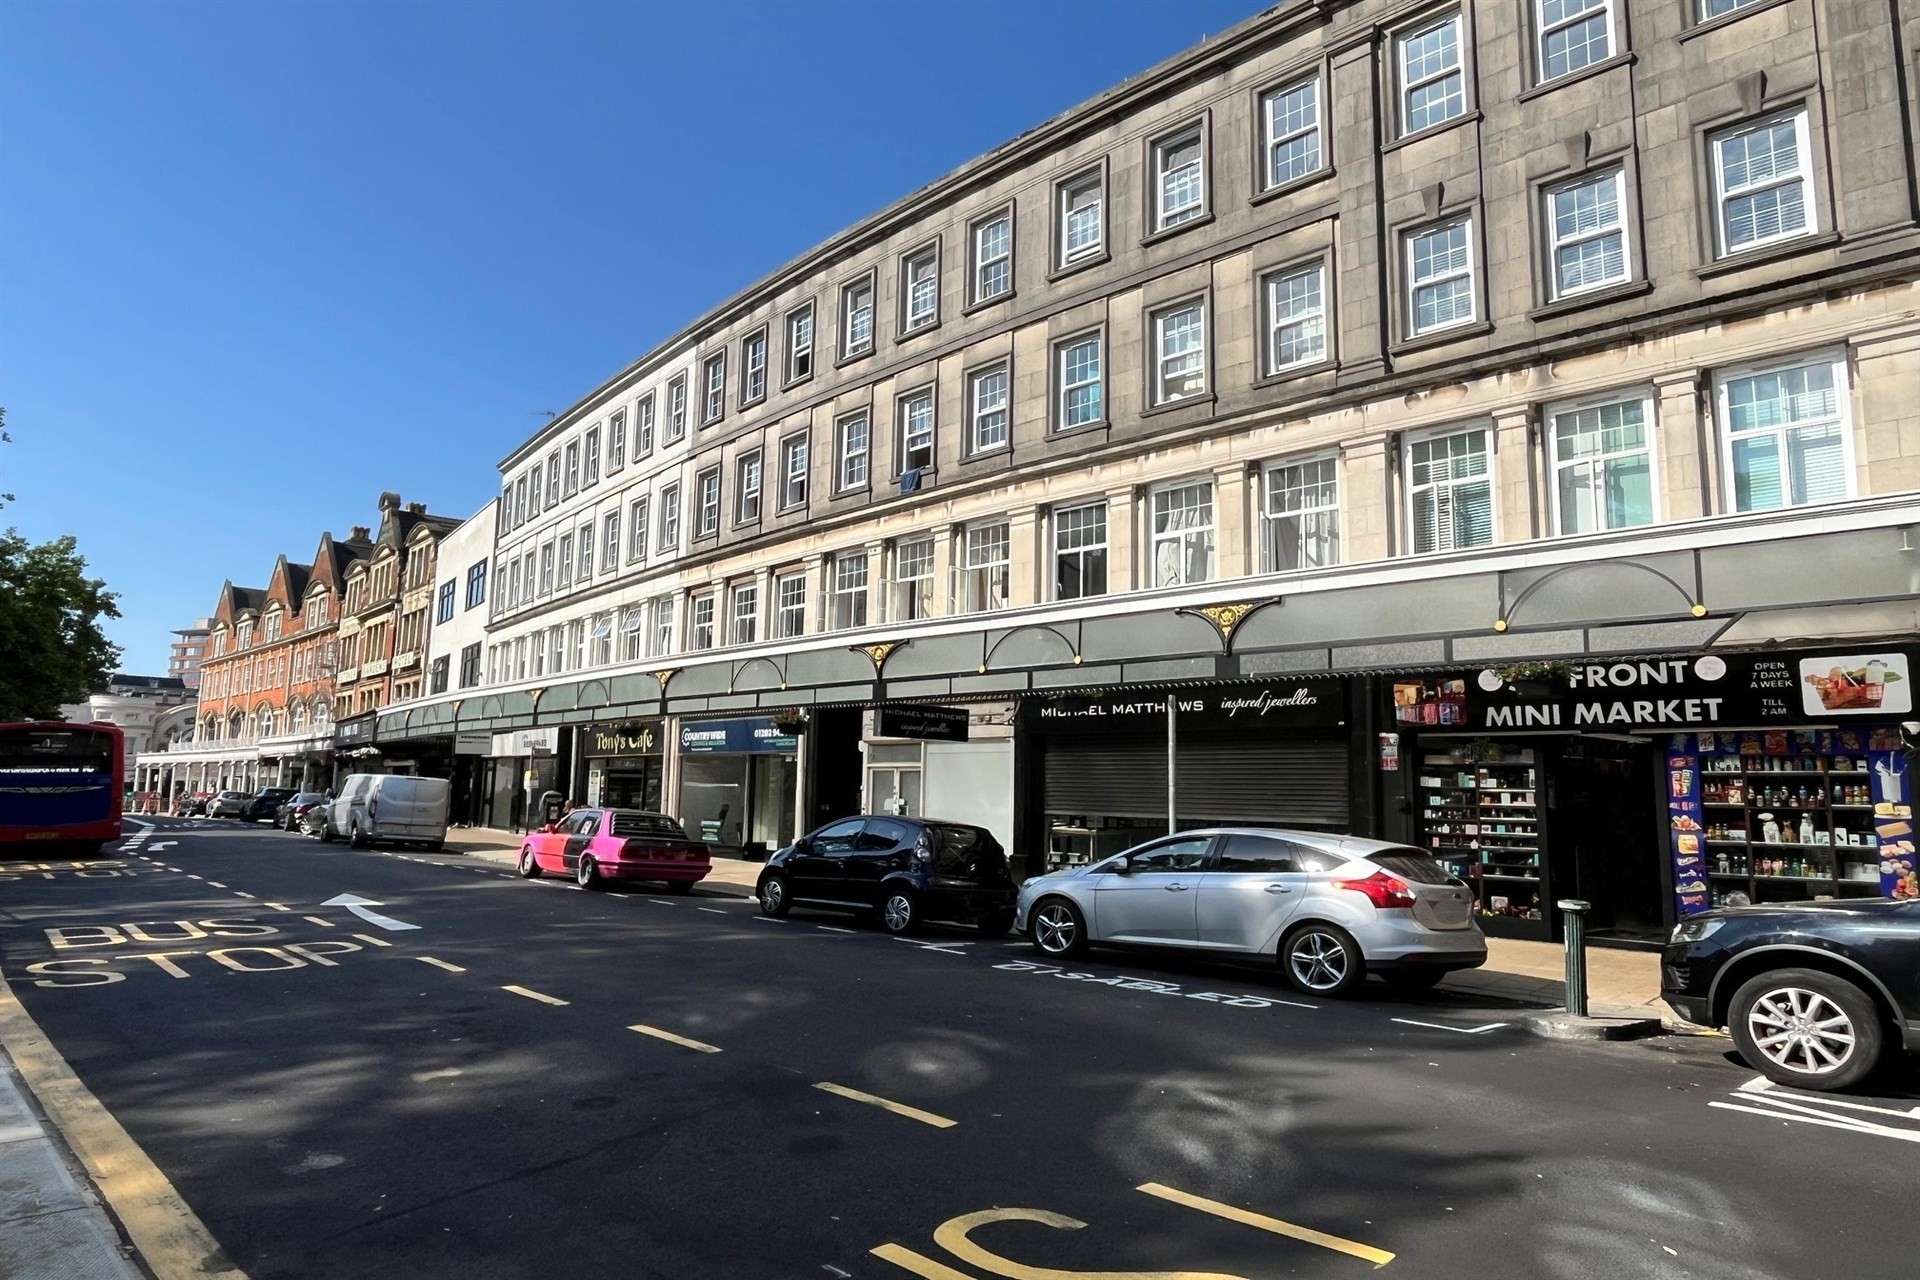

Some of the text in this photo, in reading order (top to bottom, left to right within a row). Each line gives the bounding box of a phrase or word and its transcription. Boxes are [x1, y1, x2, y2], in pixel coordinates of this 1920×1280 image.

[1569, 661, 1688, 689] FRONT
[1751, 670, 1790, 680] 7 DAYS
[1754, 662, 1785, 670] OPEN
[1750, 679, 1793, 689] A WEEK
[1112, 701, 1204, 715] MATTHWS
[1221, 690, 1269, 718] inspired
[1260, 688, 1318, 716] jewellers
[1486, 698, 1723, 727] MINI MARKET
[1761, 707, 1787, 716] 2 AM
[1762, 698, 1785, 706] TILL
[44, 918, 280, 949] BUS
[25, 941, 363, 987] STOP
[992, 963, 1272, 1008] DISABLED
